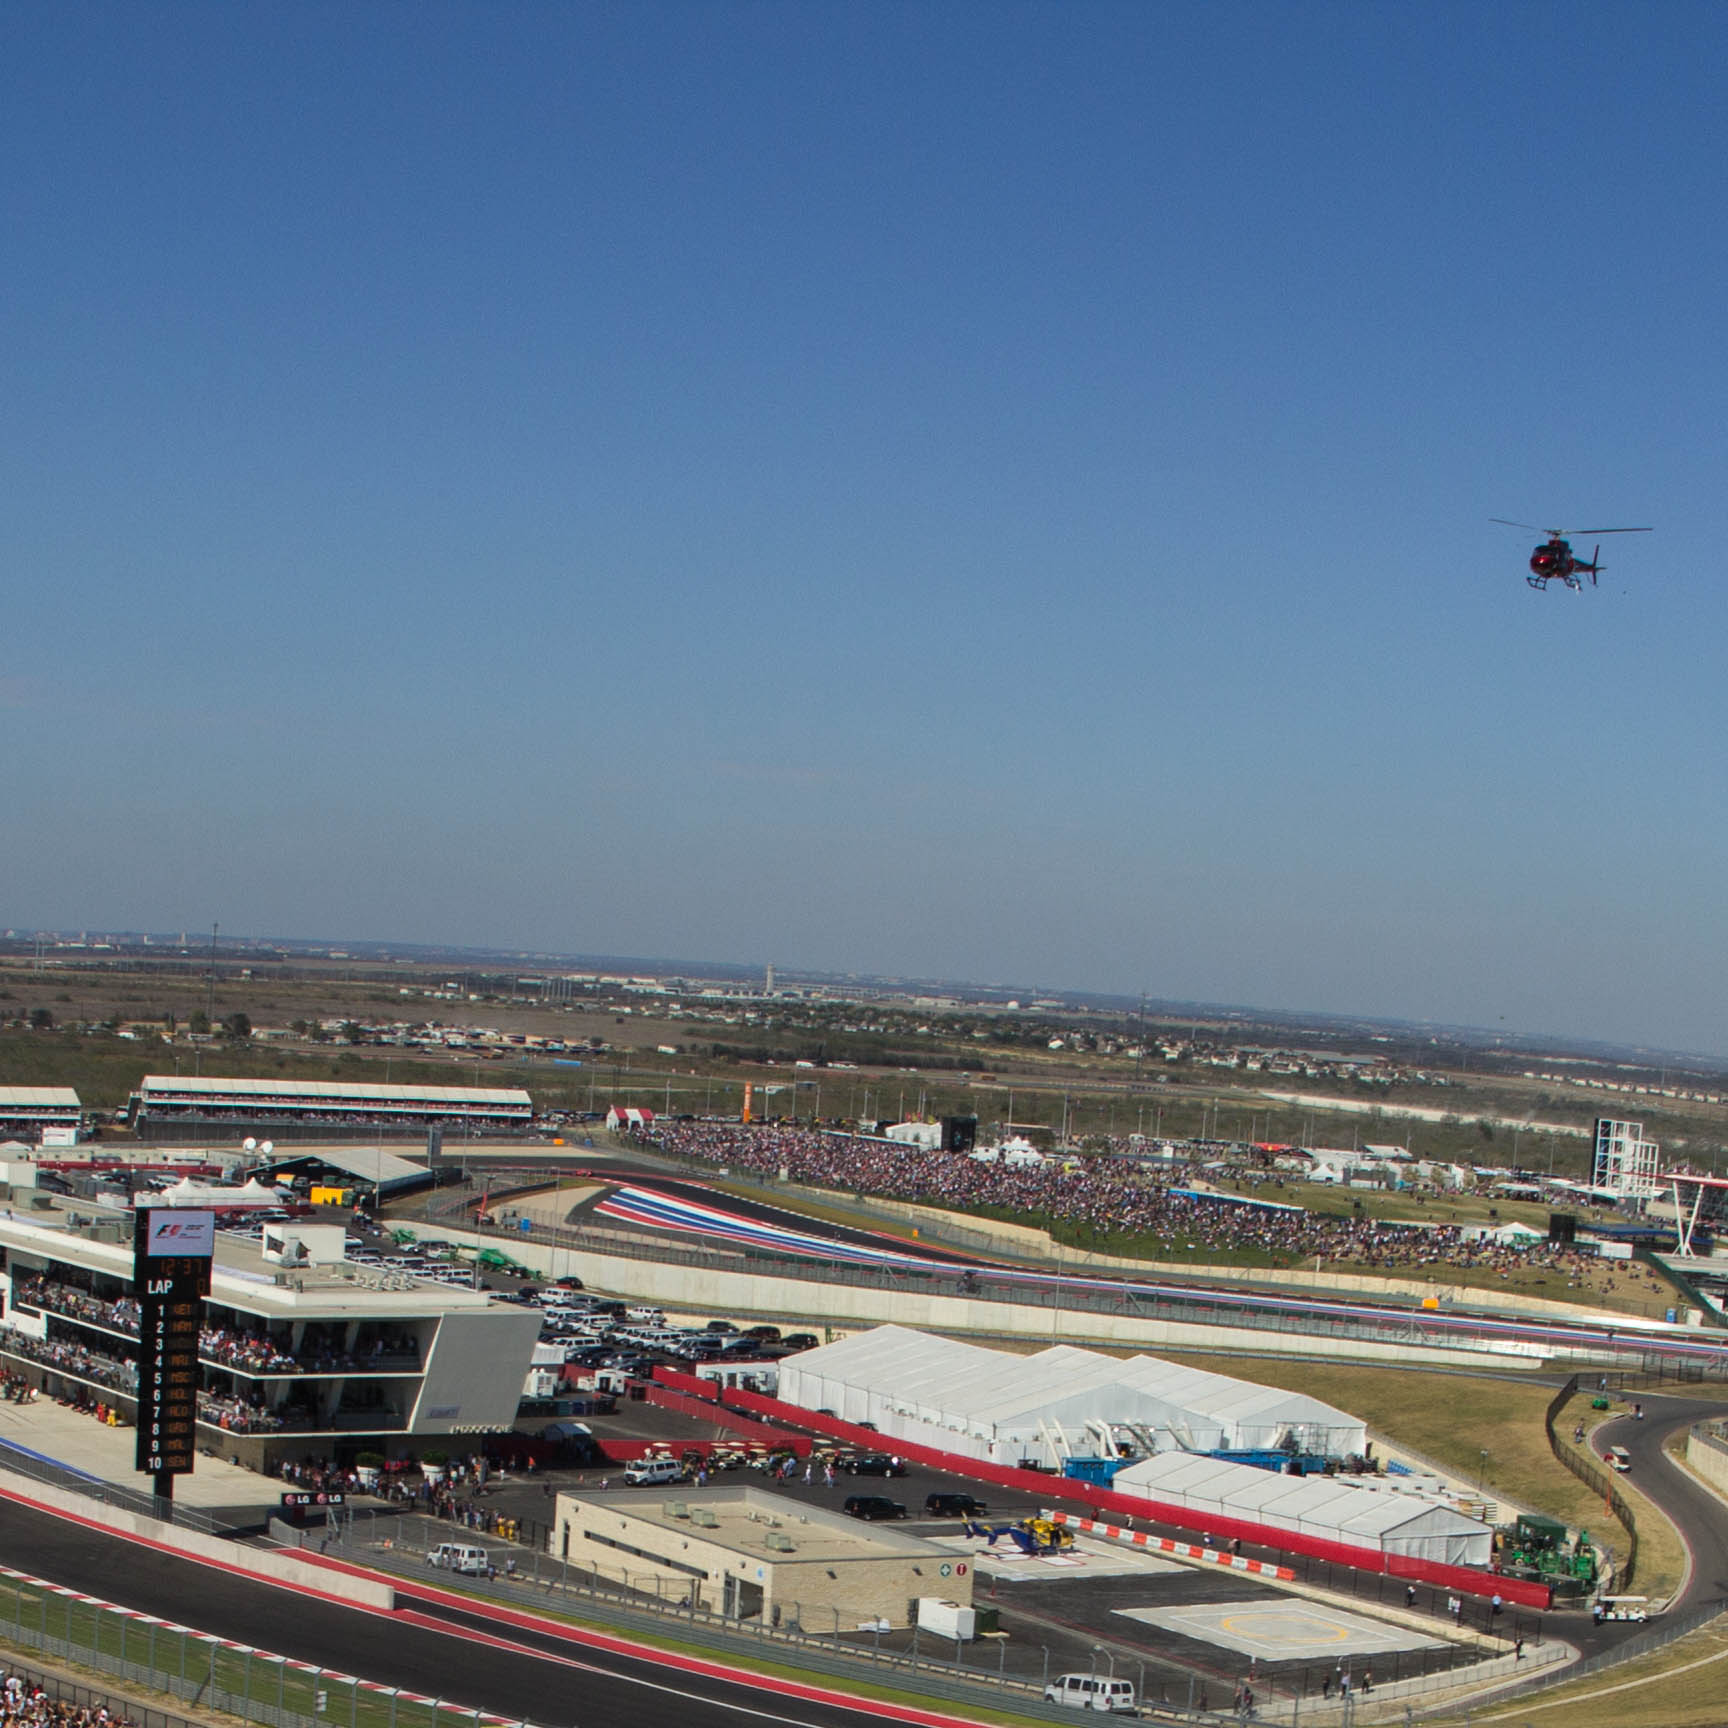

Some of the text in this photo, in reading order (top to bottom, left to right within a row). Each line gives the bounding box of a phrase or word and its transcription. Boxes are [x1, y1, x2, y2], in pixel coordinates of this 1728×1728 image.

[148, 1280, 173, 1294] LAP
[158, 1305, 164, 1316] 1
[156, 1321, 164, 1334] 2
[155, 1339, 163, 1351] 3
[154, 1355, 162, 1367] 4
[154, 1372, 162, 1384] 5
[153, 1389, 161, 1401] 6
[152, 1406, 160, 1418] 7
[152, 1423, 159, 1435] 8
[151, 1440, 159, 1452] 9
[148, 1457, 162, 1469] 10
[297, 1494, 342, 1504] LG LG
